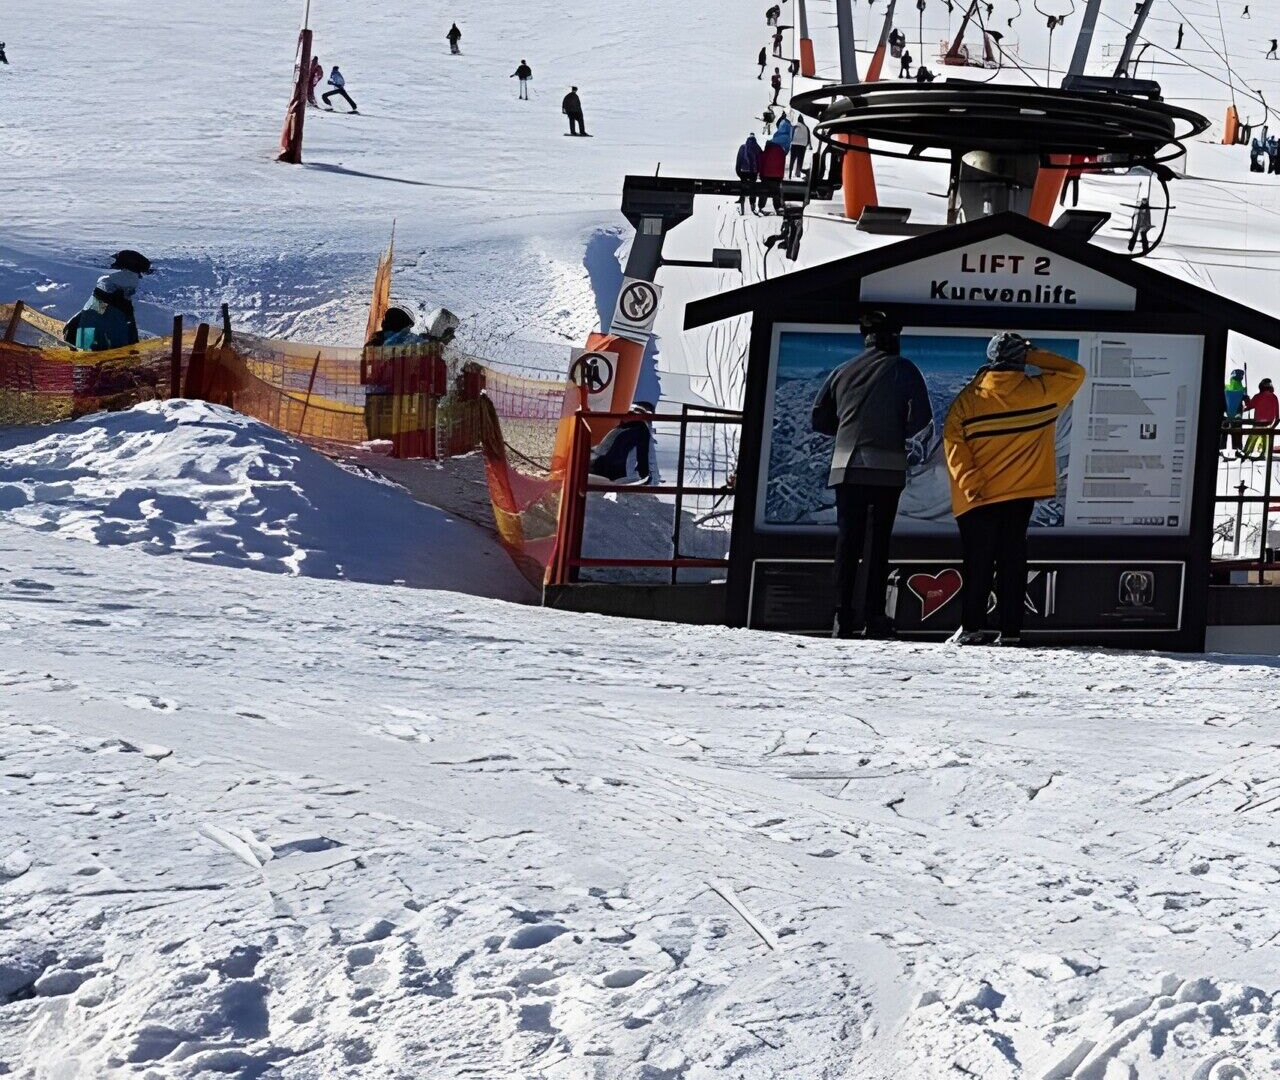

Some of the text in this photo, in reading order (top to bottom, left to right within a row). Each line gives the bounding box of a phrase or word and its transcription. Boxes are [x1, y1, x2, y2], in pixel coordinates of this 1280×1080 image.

[961, 253, 1051, 276] LIFT 2
[930, 280, 1077, 304] Kurvenlift
